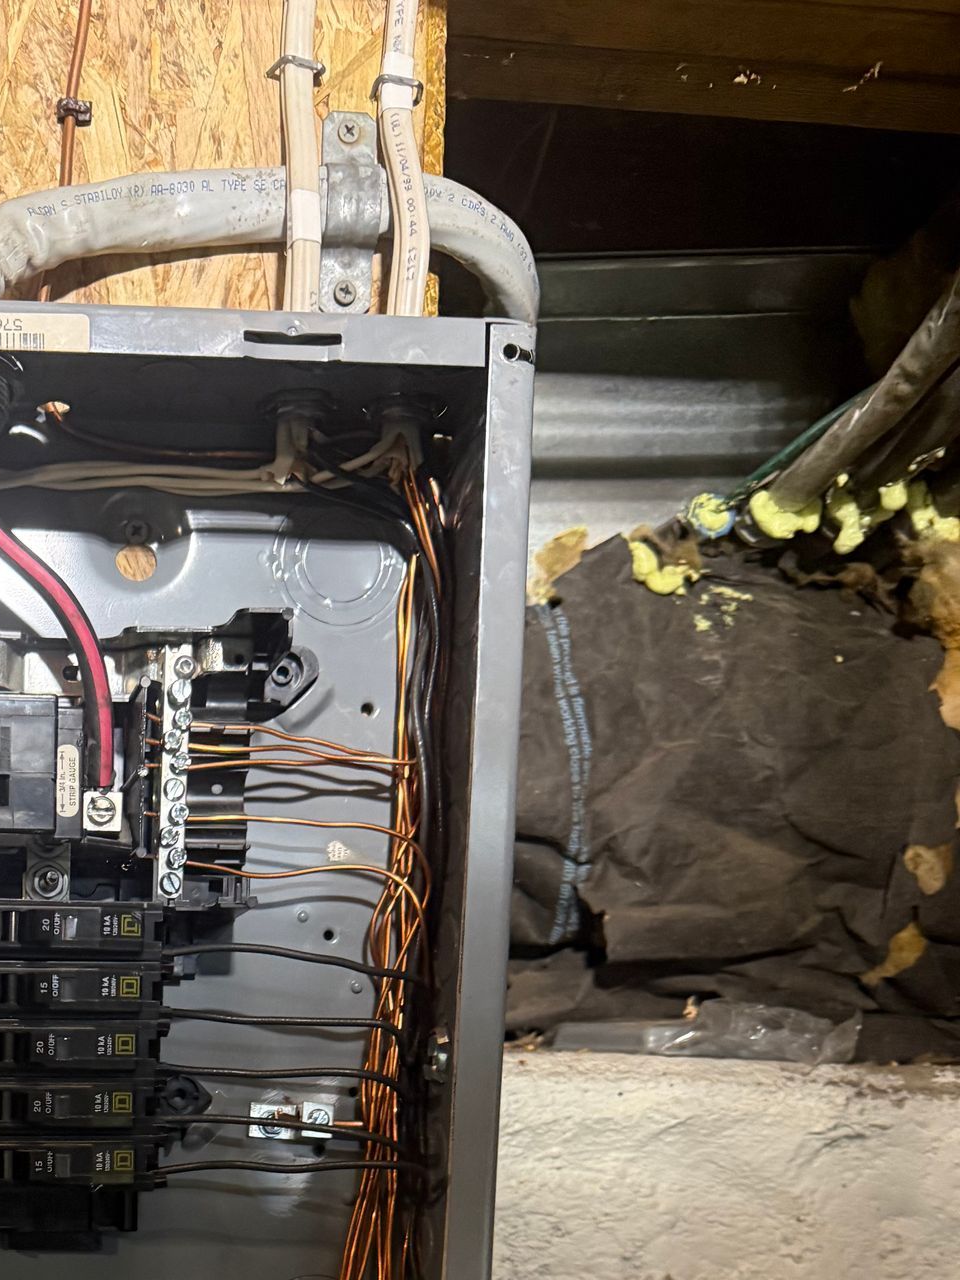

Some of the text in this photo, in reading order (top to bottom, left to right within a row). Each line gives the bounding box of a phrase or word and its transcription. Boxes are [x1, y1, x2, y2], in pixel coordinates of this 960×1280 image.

[150, 180, 195, 197] AA-8030
[221, 179, 247, 192] TYPE
[42, 918, 50, 931] 20
[40, 982, 48, 993] 15
[36, 1041, 44, 1054] 20
[34, 1100, 41, 1113] 20
[35, 1160, 42, 1172] 15
